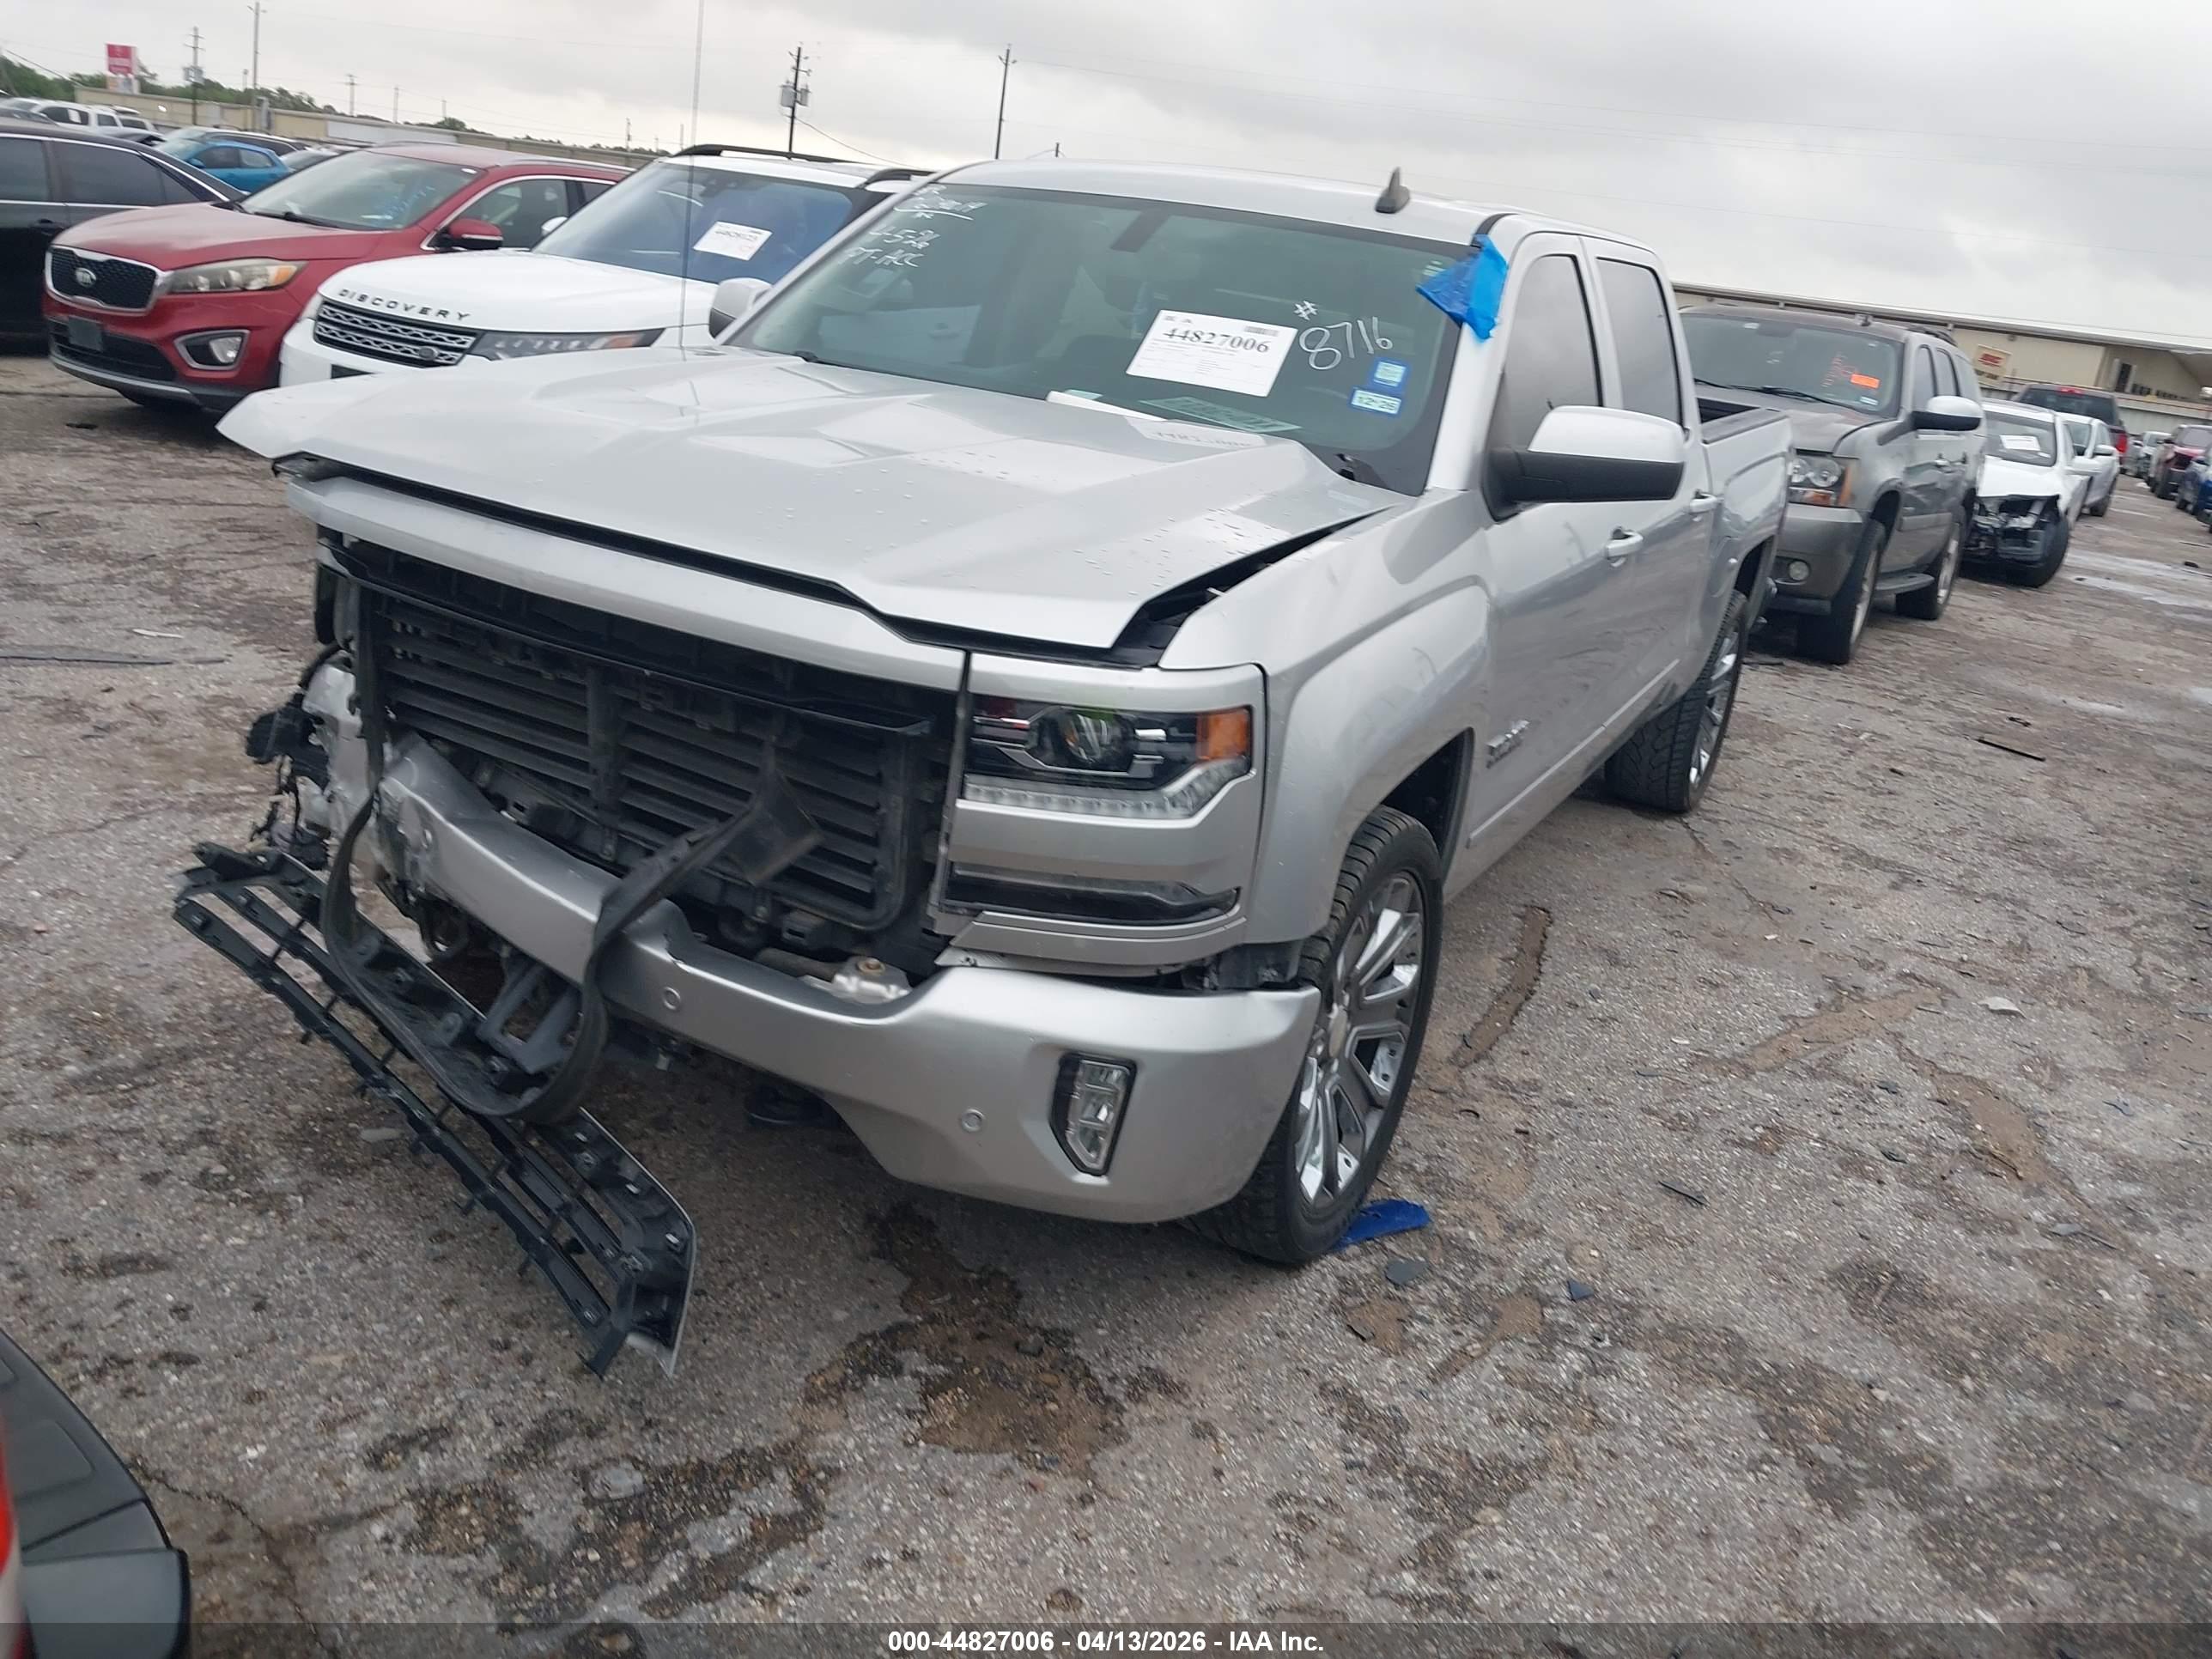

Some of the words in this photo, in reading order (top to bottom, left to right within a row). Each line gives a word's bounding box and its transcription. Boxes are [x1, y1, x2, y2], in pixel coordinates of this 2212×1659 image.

[338, 289, 471, 320] DISCOVERY
[1293, 300, 1318, 320] #
[1163, 327, 1271, 353] 44827006
[1298, 316, 1394, 370] 8716
